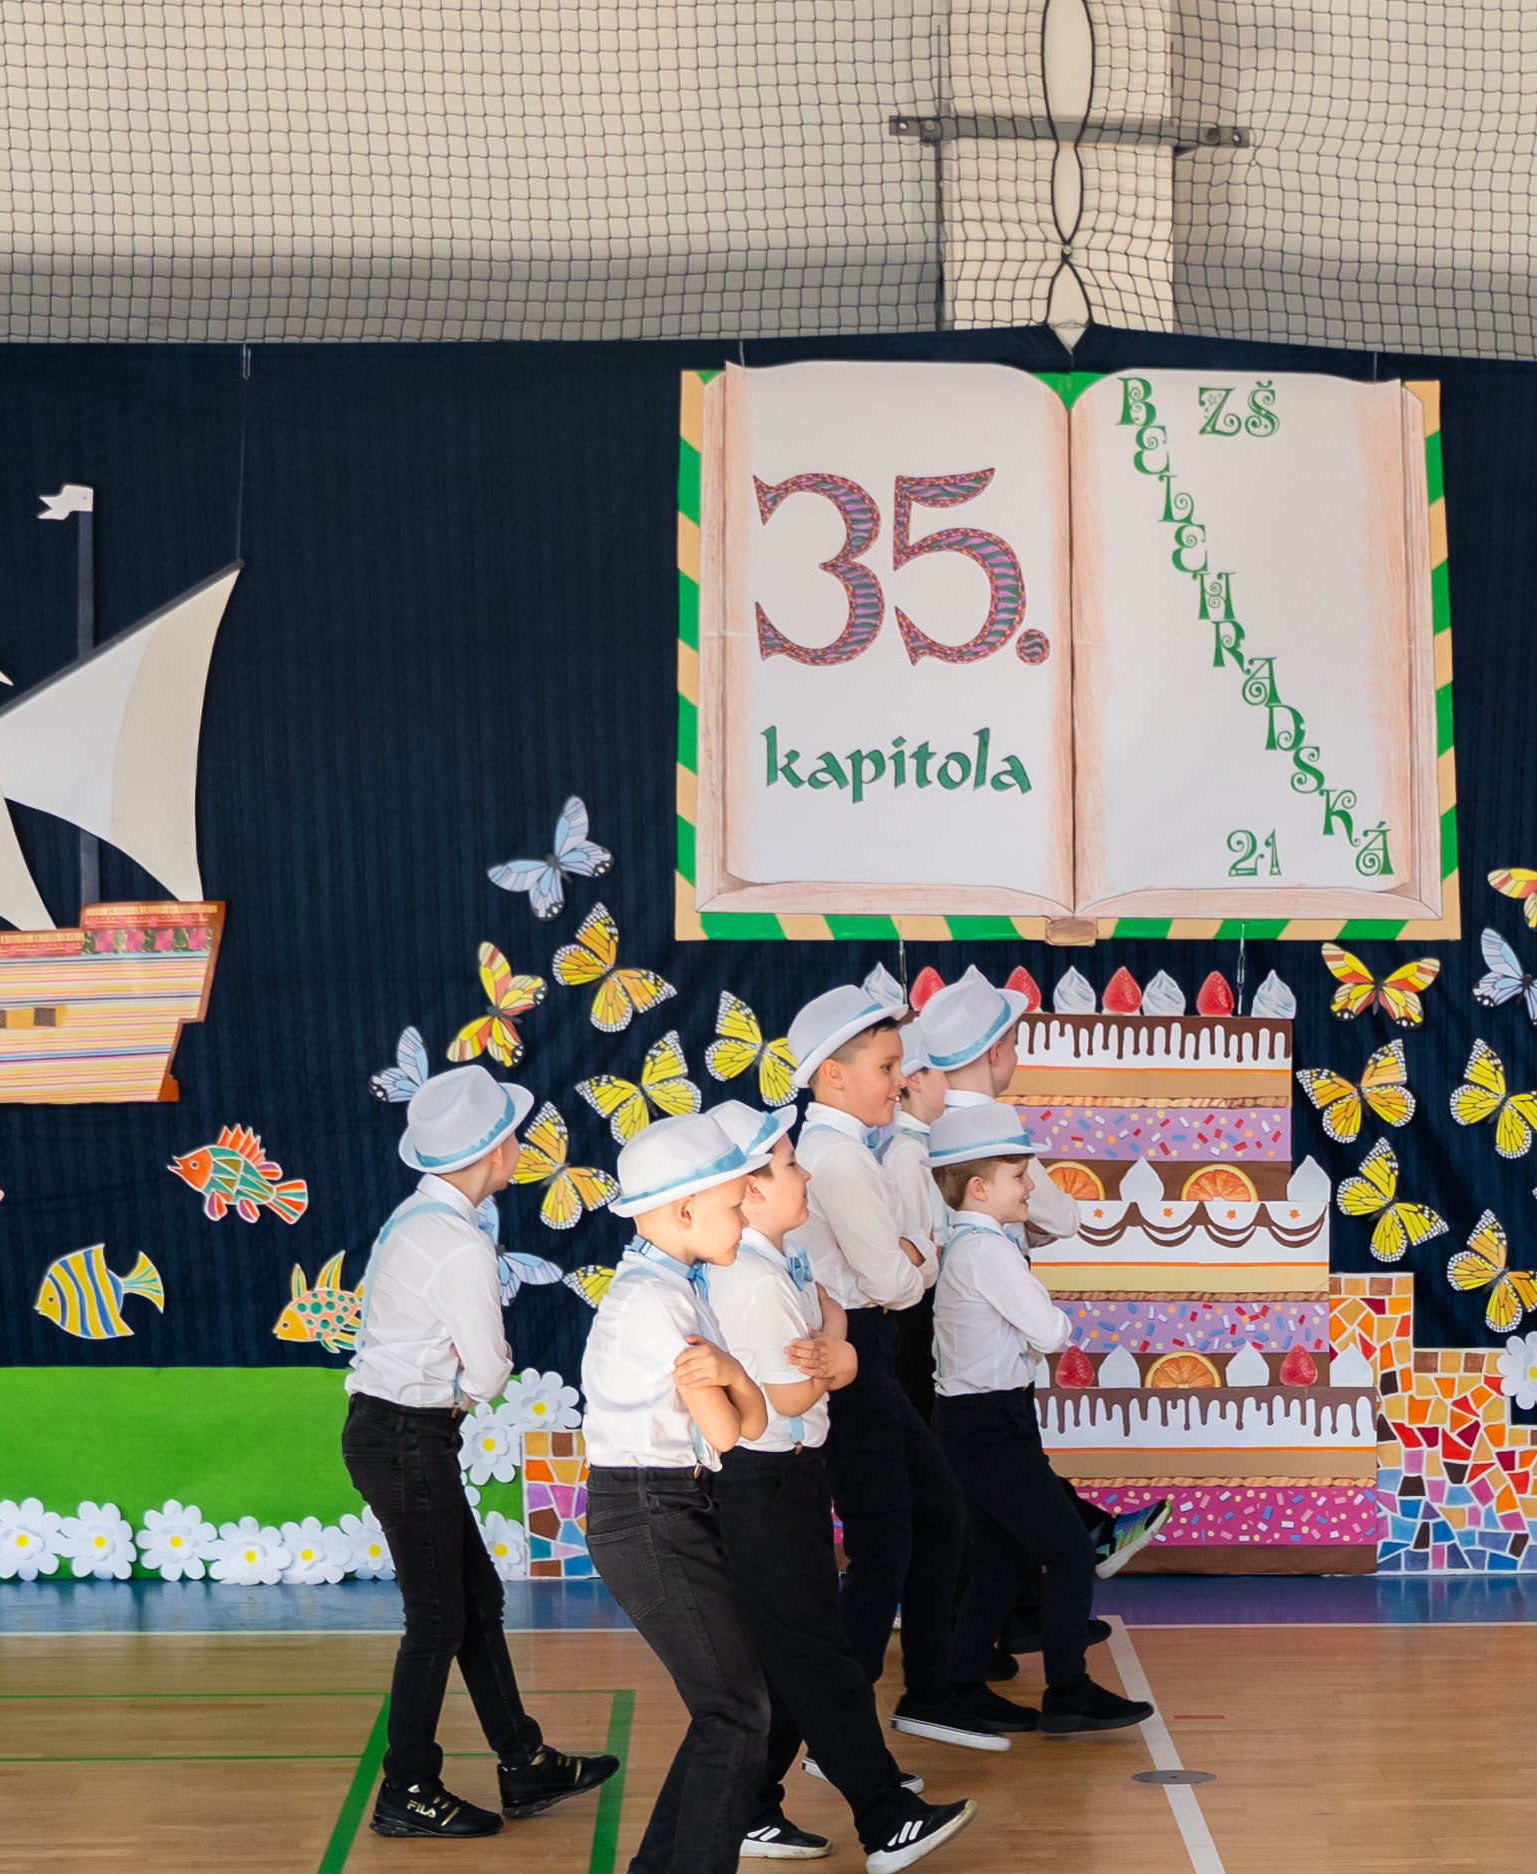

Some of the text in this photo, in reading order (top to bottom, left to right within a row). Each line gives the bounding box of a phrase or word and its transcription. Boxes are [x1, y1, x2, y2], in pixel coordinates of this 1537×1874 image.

[1197, 380, 1280, 438] ZŠ
[752, 466, 1051, 667] 35.
[1116, 376, 1395, 877] BELEHRADSKÁ
[764, 725, 1033, 803] kapitola
[1226, 828, 1282, 877] 21
[406, 1799, 437, 1819] FILA
